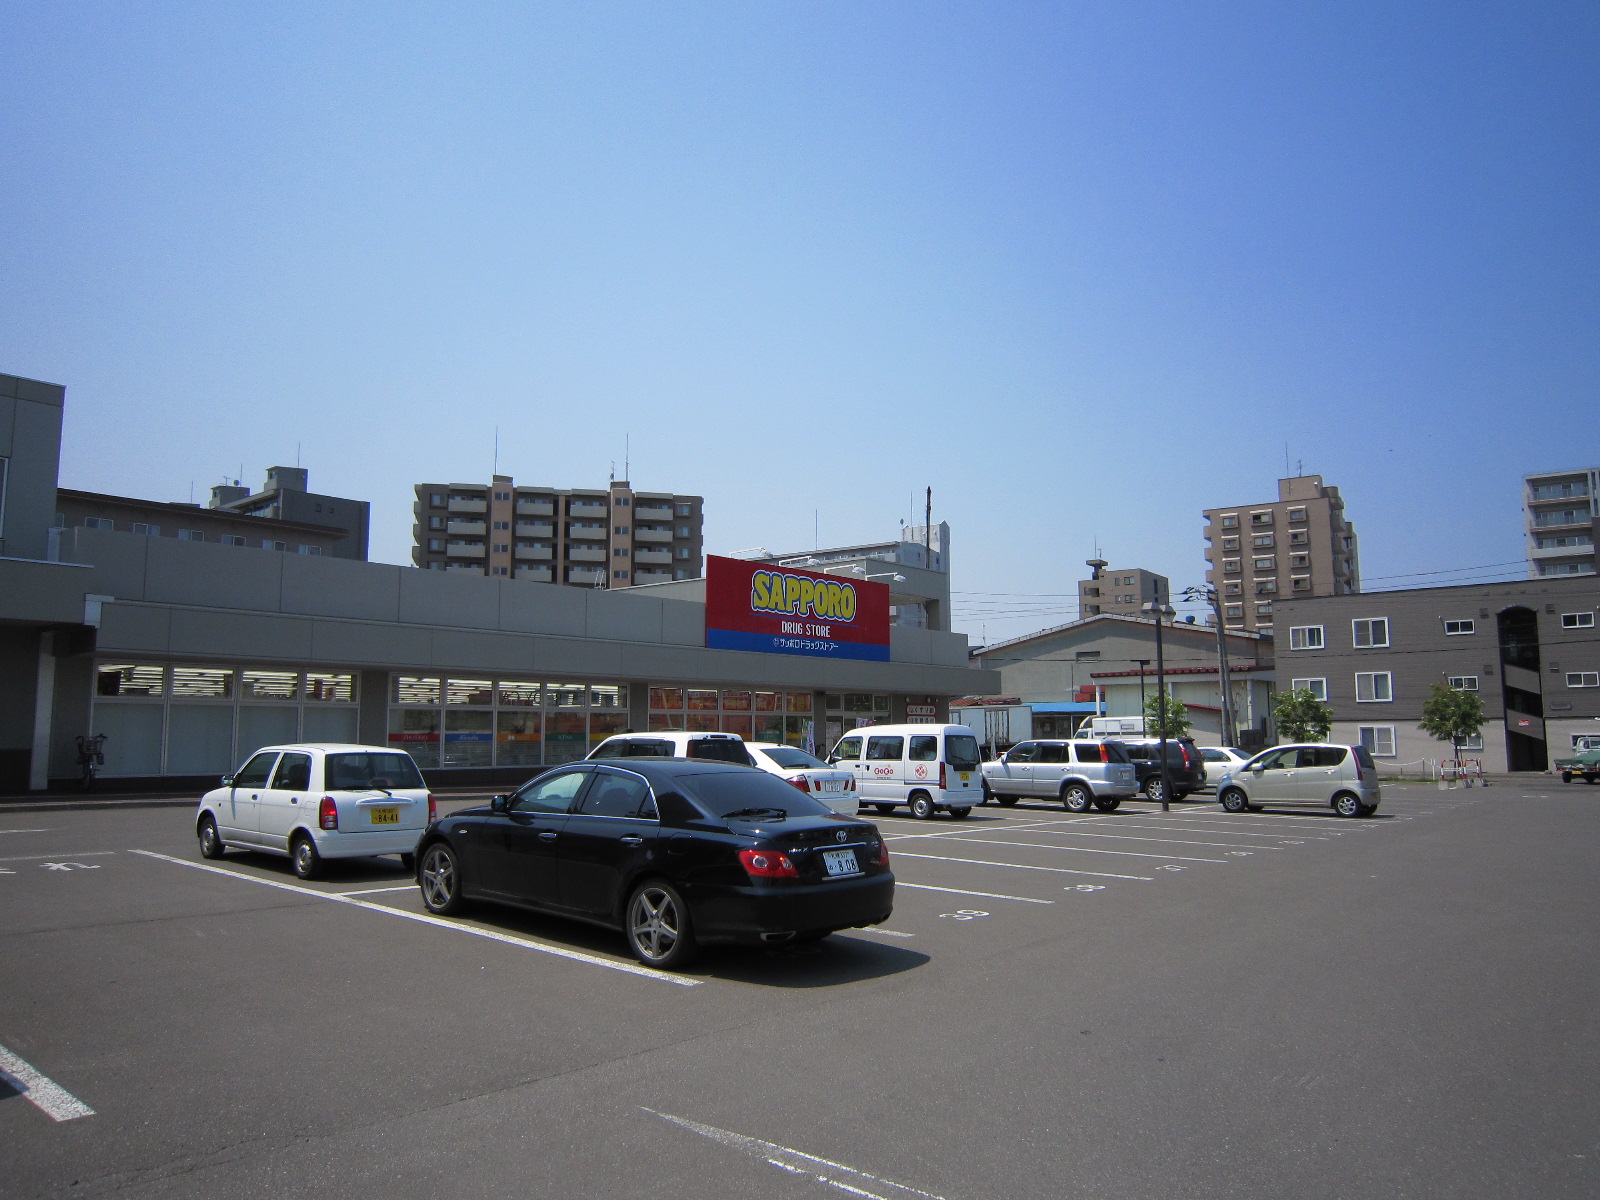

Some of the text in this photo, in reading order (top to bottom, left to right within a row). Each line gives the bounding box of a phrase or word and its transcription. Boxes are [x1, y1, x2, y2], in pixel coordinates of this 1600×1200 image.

[752, 570, 857, 622] SAPPORO
[781, 621, 831, 638] DRUG STORE
[939, 909, 990, 921] 39
